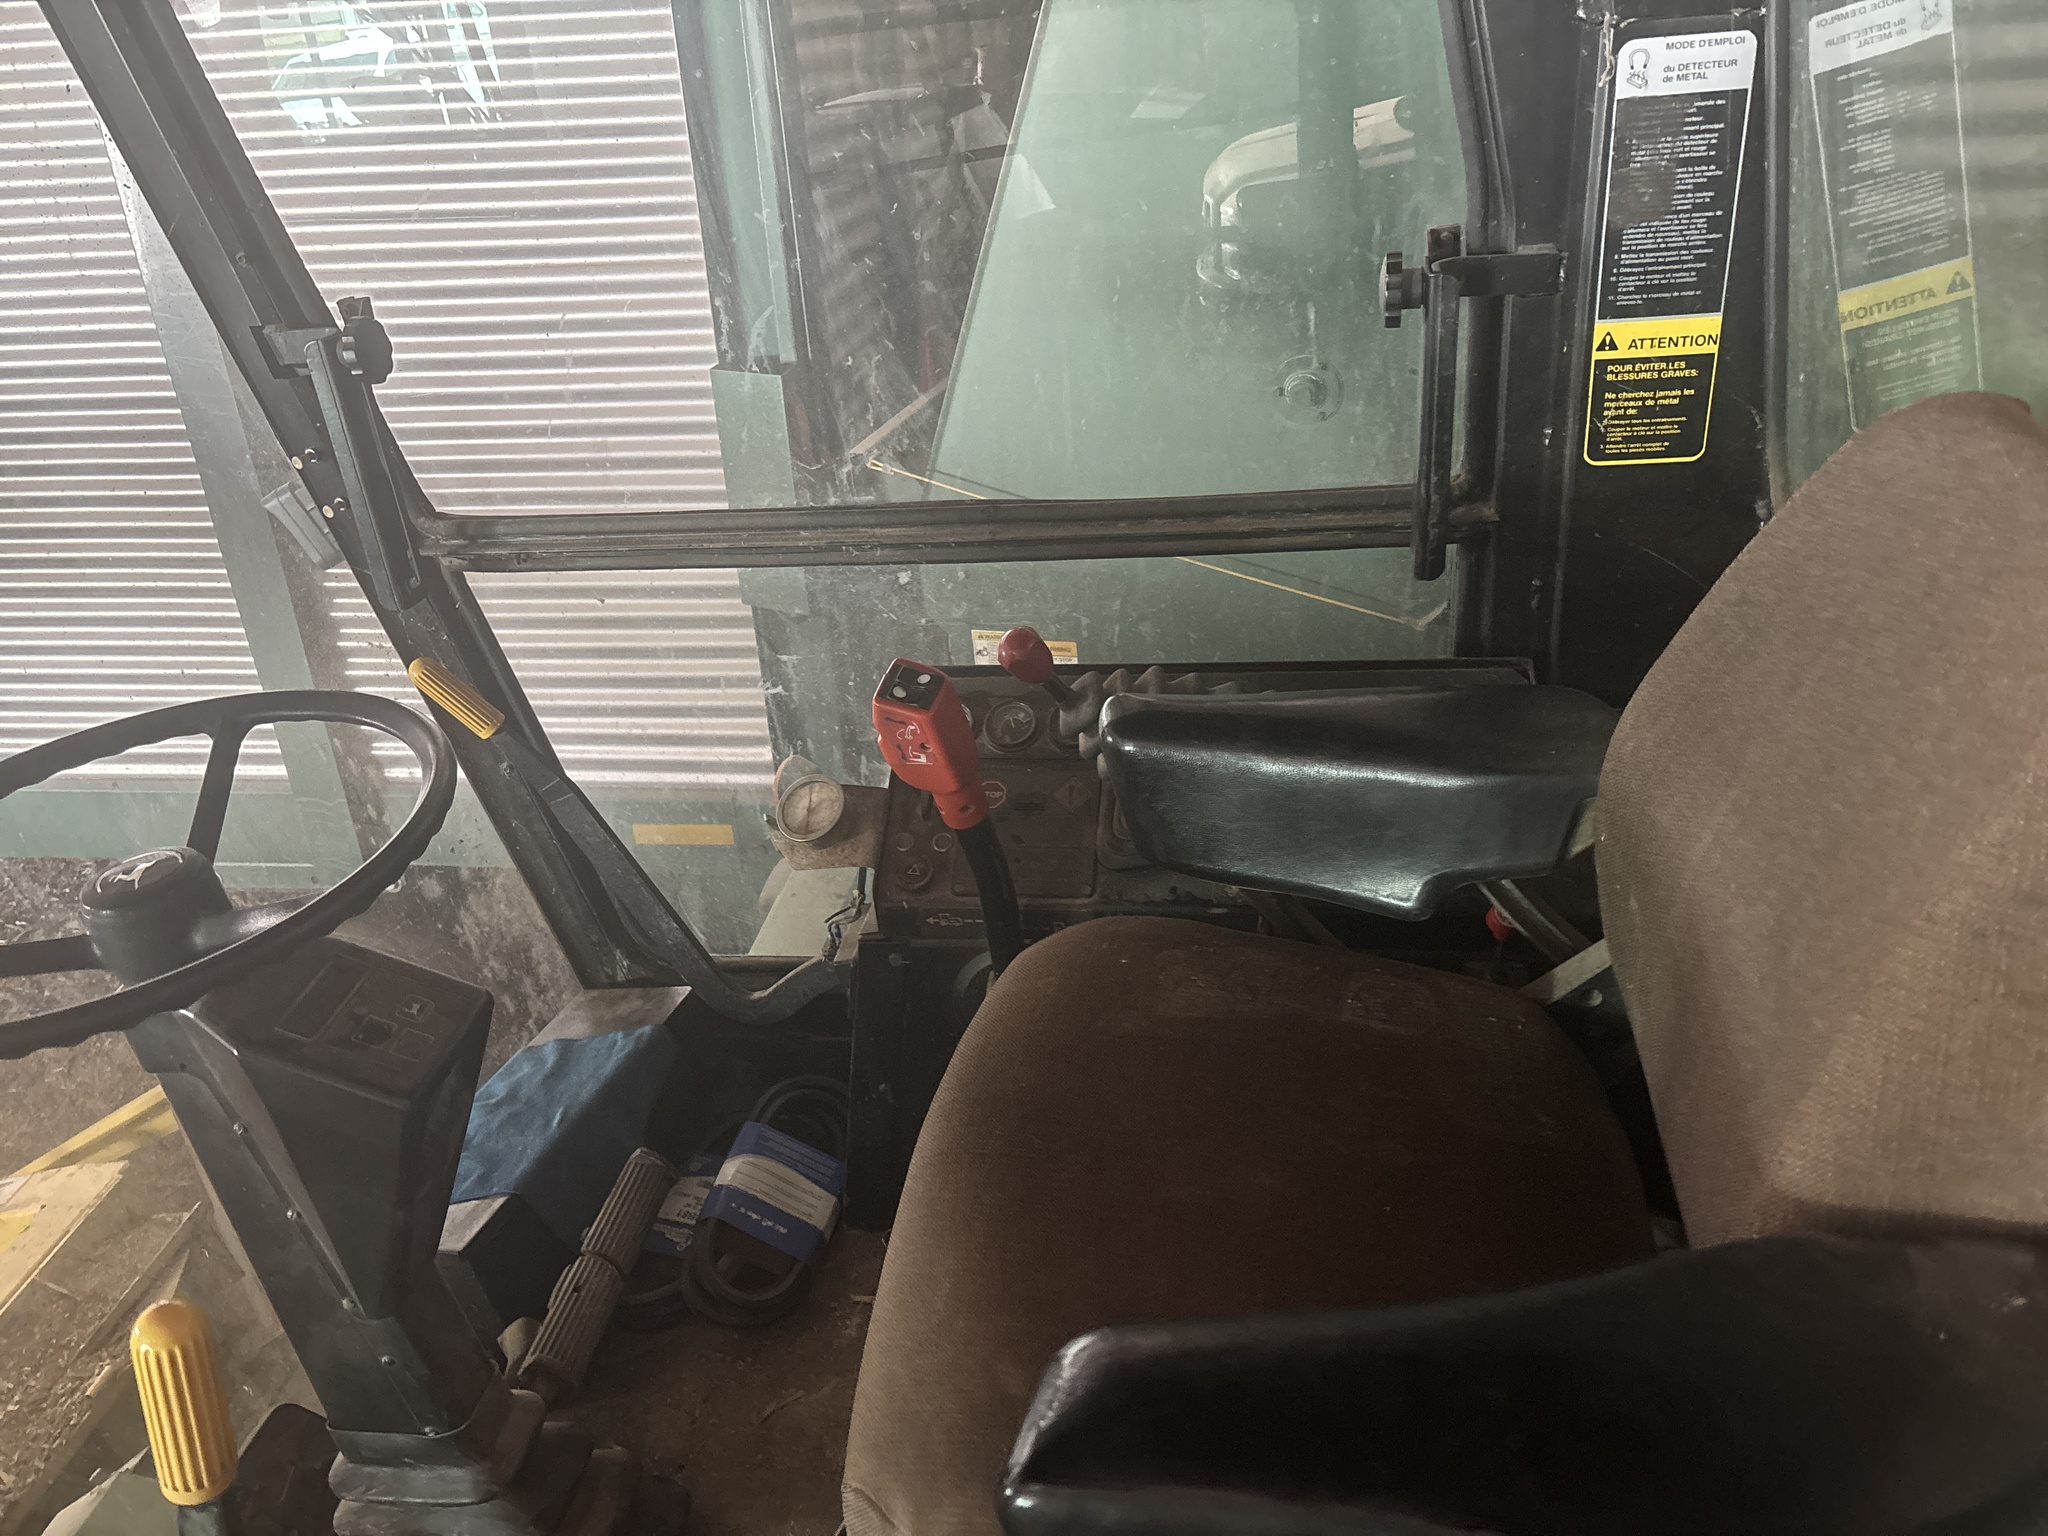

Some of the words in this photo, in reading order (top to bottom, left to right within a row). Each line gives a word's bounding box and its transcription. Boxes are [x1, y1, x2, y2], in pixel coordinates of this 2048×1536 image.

[1665, 40, 1696, 51] MODE
[1698, 36, 1746, 47] D'EMPLOI
[1663, 64, 1675, 73] du
[1677, 59, 1738, 72] DETECTEUR
[1662, 74, 1674, 83] de
[1676, 71, 1709, 82] METAL
[1628, 333, 1719, 351] ATTENTION
[1607, 364, 1633, 373] POUR
[1634, 362, 1667, 371] ÉVITER
[1668, 361, 1686, 369] LES
[1606, 371, 1659, 381] BLESSURES
[1660, 369, 1699, 378] GRAVES:
[1617, 390, 1654, 399] cherchez
[1655, 389, 1682, 398] jamais
[1683, 388, 1695, 396] les
[1603, 399, 1643, 408] morceaux
[1644, 398, 1655, 406] de
[1656, 396, 1680, 405] métal
[1603, 407, 1625, 417] avant
[1625, 407, 1638, 415] de:
[984, 790, 1004, 799] TOP
